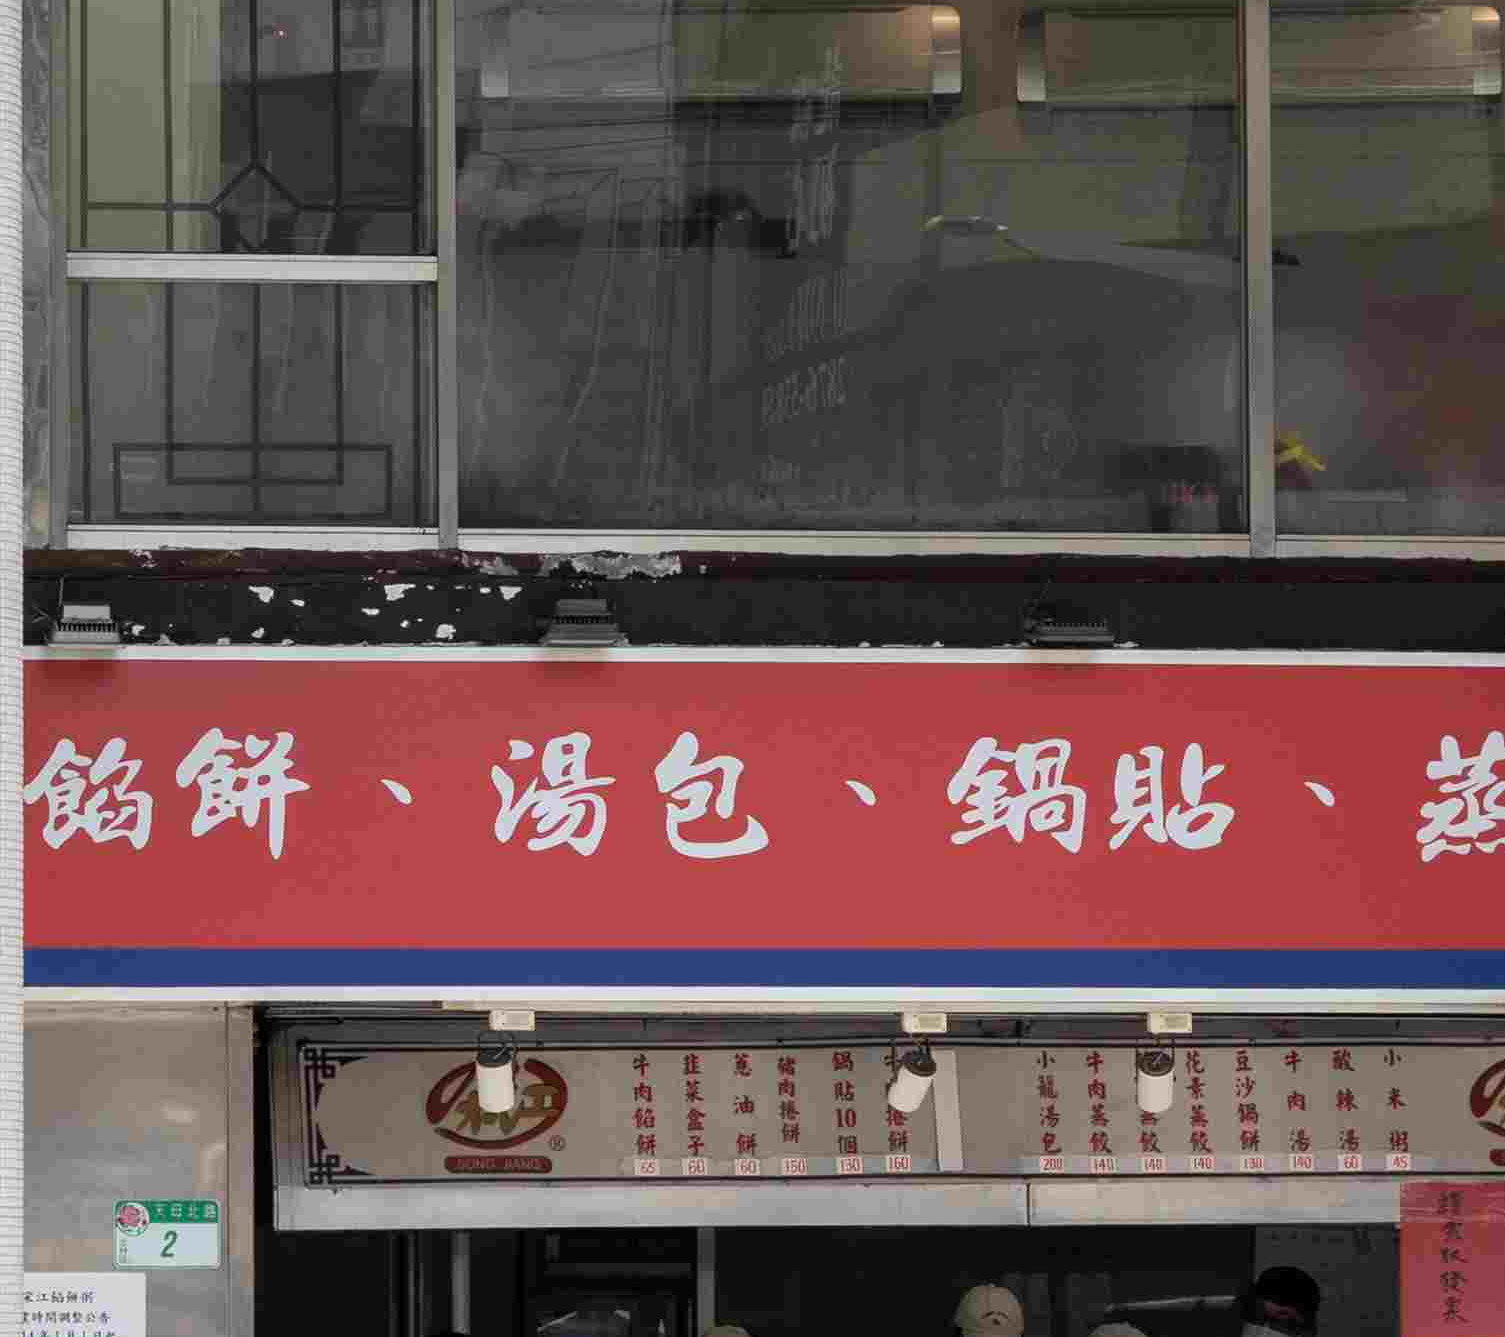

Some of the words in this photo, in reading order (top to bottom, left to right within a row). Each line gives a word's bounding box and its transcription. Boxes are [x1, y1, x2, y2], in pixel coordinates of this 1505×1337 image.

[631, 1052, 657, 1156] 牛肉餡餅
[683, 1052, 706, 1156] 韭菜盒子
[831, 1051, 858, 1155] 鍋貼10個
[1086, 1049, 1113, 1153] 牛肉蒸餃
[1184, 1050, 1212, 1153] 花素蒸餃
[1234, 1049, 1261, 1152] 豆沙鍋餅
[1283, 1049, 1311, 1151] 牛肉湯
[1331, 1048, 1360, 1151] 酸辣湯
[1383, 1047, 1409, 1152] 小米粥
[740, 1160, 757, 1174] 60
[1043, 1157, 1063, 1170] 200
[160, 1230, 178, 1258] 2
